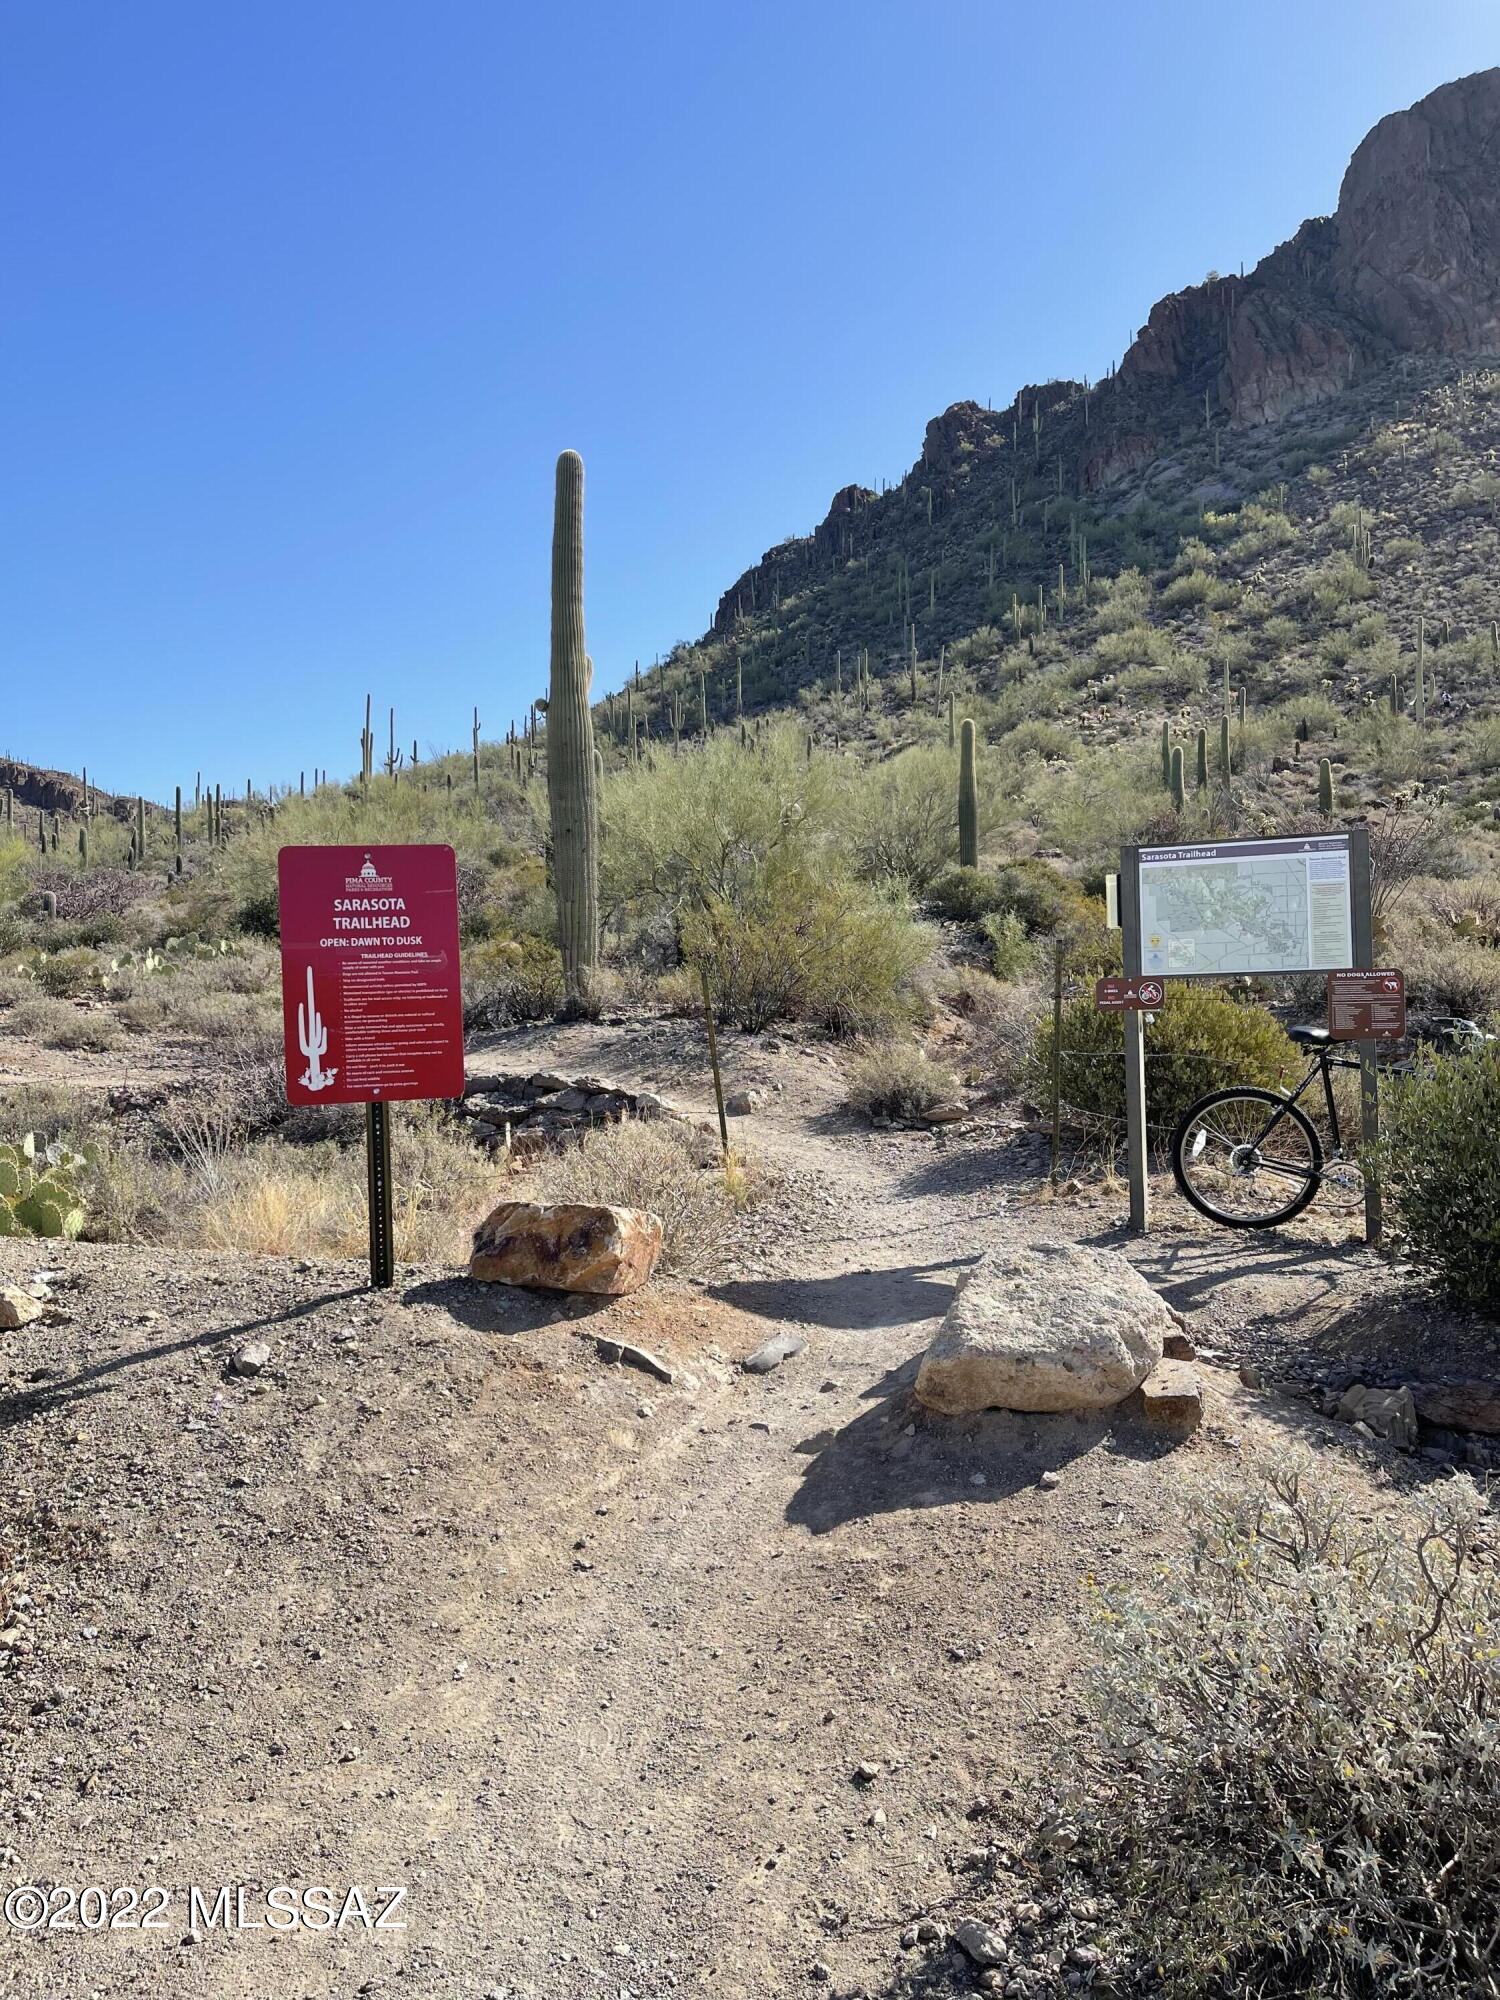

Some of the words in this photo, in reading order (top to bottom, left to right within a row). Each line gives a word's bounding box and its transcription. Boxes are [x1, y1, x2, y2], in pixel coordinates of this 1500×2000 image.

[1141, 852, 1177, 861] Sarasota
[1178, 849, 1217, 859] Trailhead
[334, 898, 406, 912] SARASOTA
[333, 916, 411, 930] TRAILHEAD
[320, 938, 350, 947] OPEN:
[351, 937, 382, 947] DAWN
[382, 936, 396, 946] TO
[397, 935, 423, 945] DUSK
